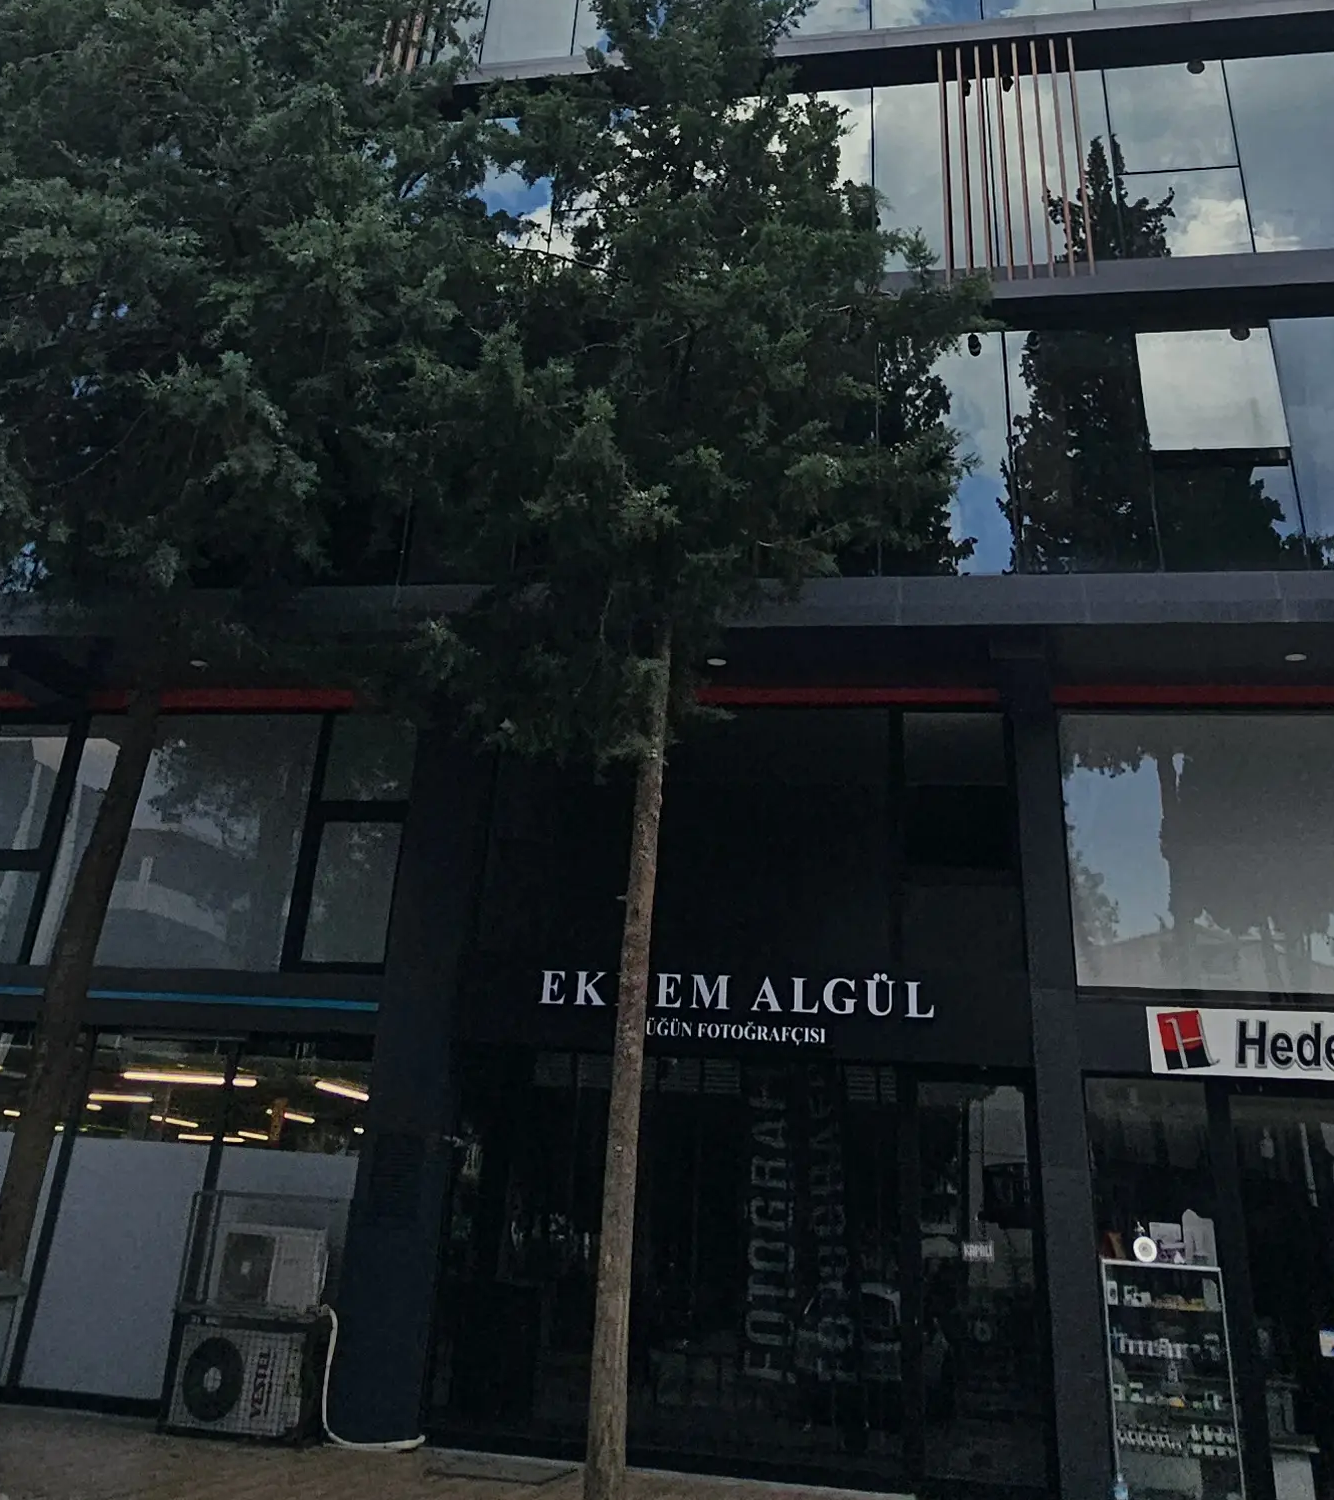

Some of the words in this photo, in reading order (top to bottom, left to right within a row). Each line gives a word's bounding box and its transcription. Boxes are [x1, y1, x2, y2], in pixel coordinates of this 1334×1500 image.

[538, 969, 731, 1011] EKEM
[751, 972, 936, 1020] ALGÜL
[646, 1016, 693, 1038] ÜĞÜN
[697, 1021, 827, 1047] FOTOĞRAFÇISI
